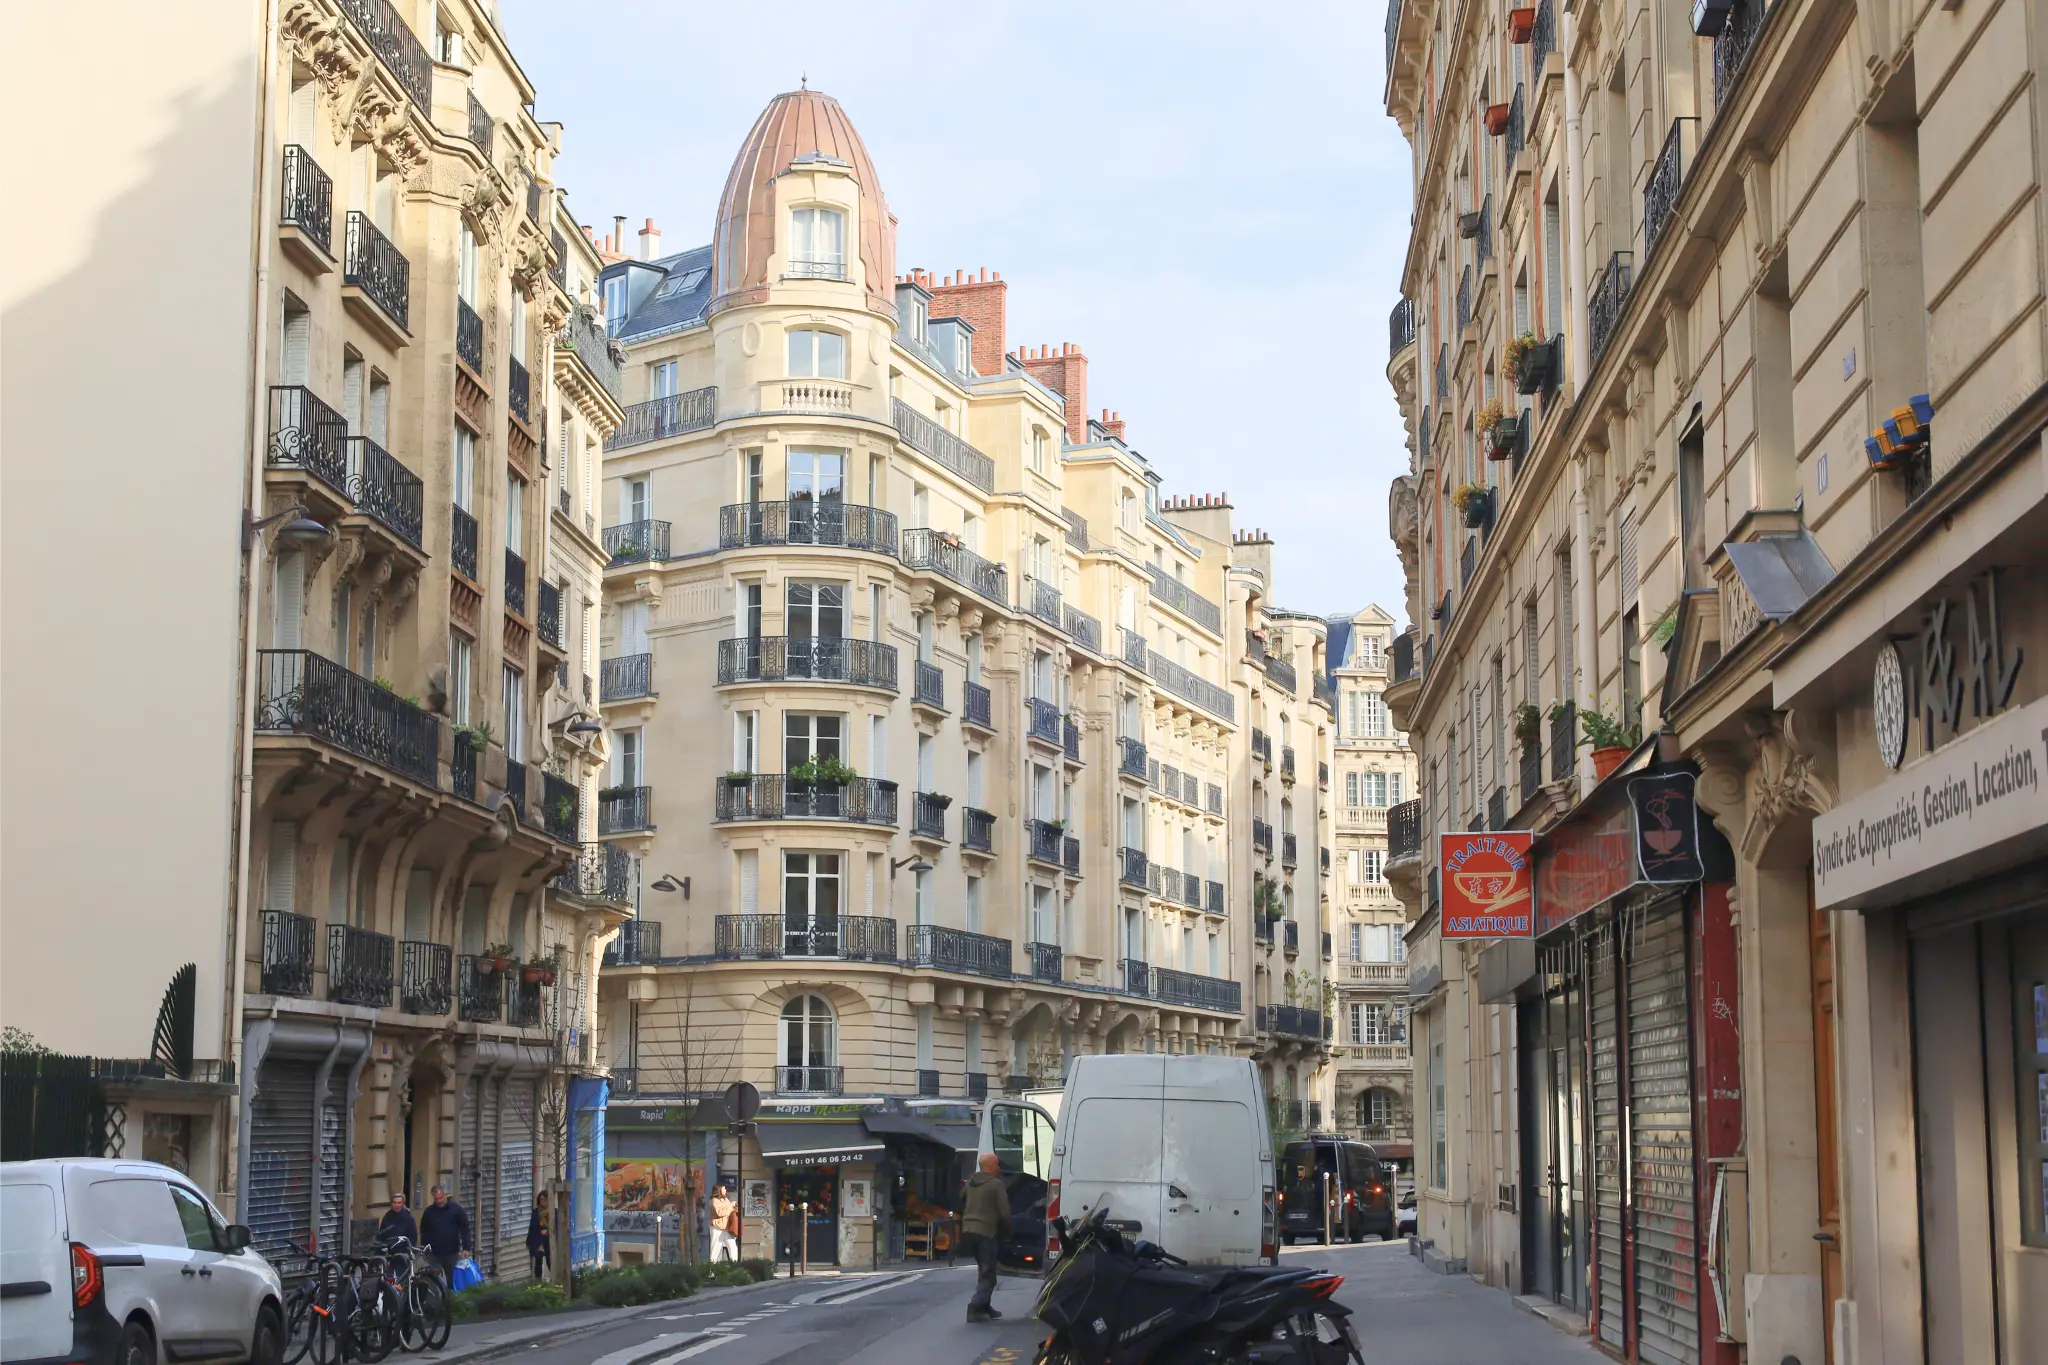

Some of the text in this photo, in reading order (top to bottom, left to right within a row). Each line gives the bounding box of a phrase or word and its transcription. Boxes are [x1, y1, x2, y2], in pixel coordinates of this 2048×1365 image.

[1819, 457, 1826, 491] 10
[1816, 832, 1844, 885] Syndic
[1845, 826, 1857, 864] de
[1858, 791, 1921, 866] Copropriété,
[1923, 774, 1972, 828] Gestion,
[1974, 745, 2038, 807] Location,
[1446, 838, 1526, 872] TRAITEUR
[1447, 916, 1529, 934] ASIATIQUE
[785, 1158, 798, 1166] Tél
[829, 1155, 839, 1163] 06
[841, 1154, 851, 1162] 24
[853, 1153, 863, 1161] 42
